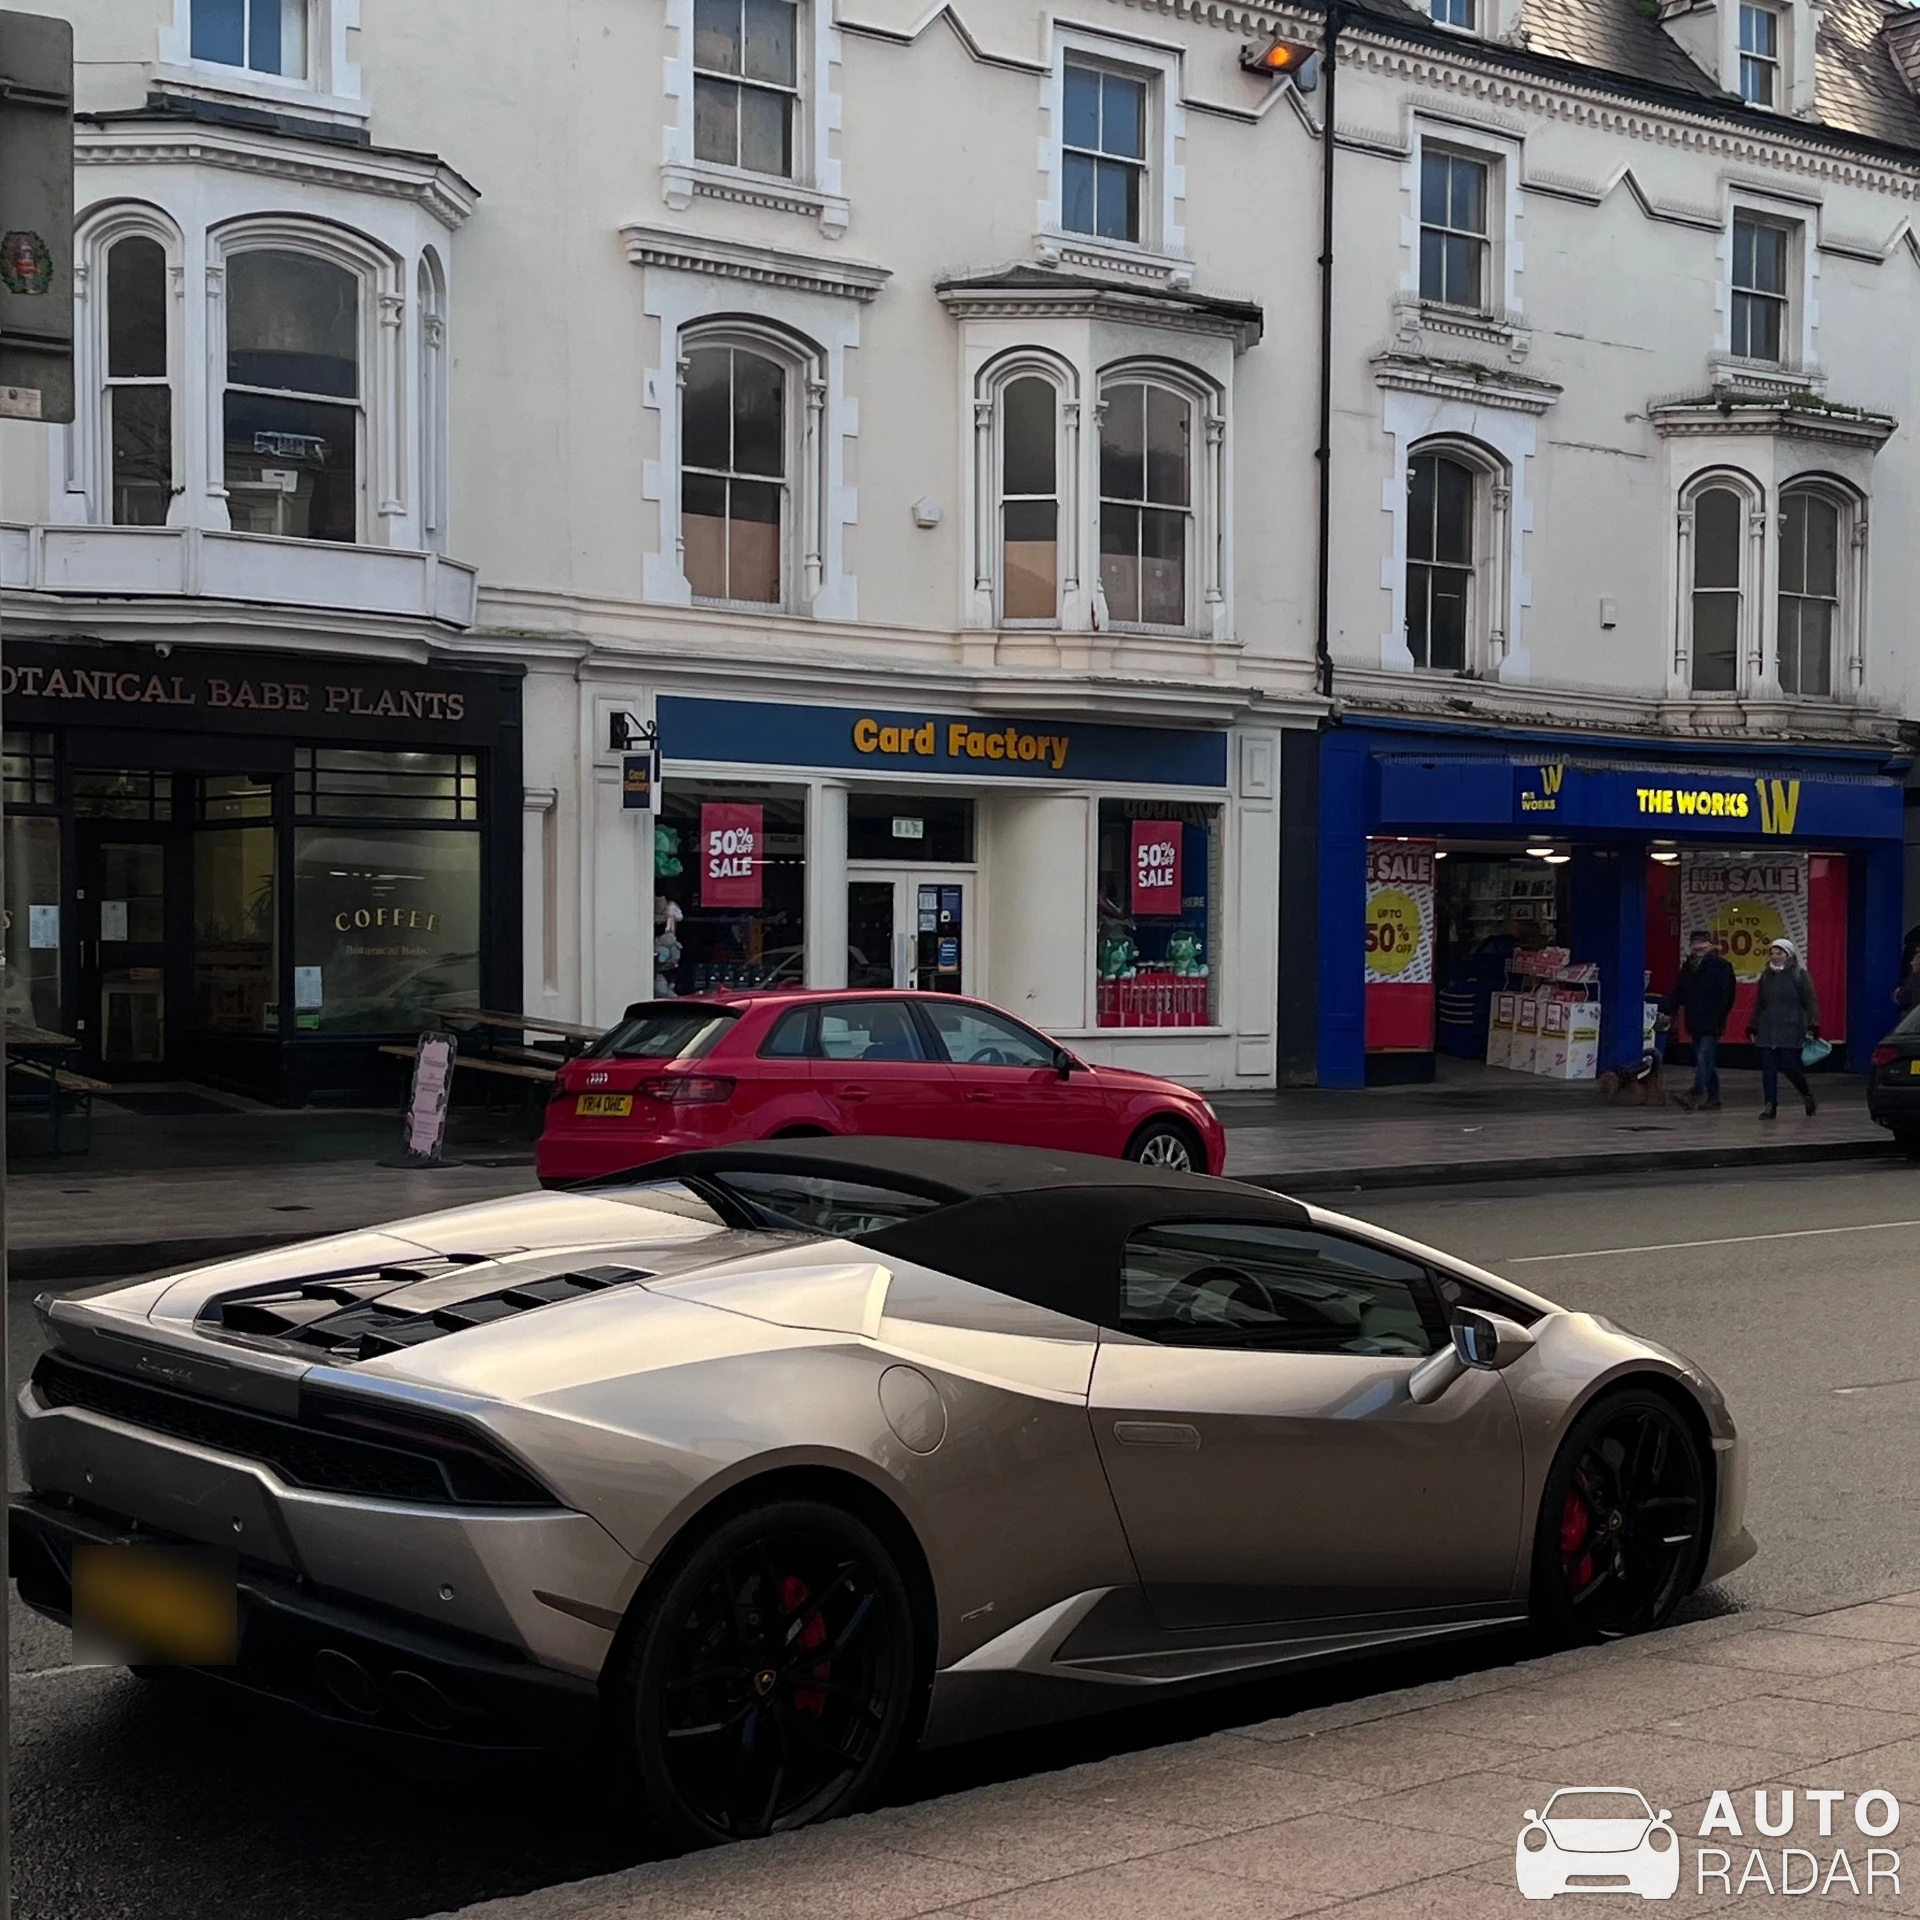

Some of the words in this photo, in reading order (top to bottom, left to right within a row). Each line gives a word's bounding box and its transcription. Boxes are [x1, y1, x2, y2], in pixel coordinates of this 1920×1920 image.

[207, 679, 309, 711] BABE
[325, 685, 465, 720] PLANTS
[854, 718, 934, 755] Card
[949, 723, 1069, 769] Factory
[1521, 799, 1556, 811] WORKS
[1636, 788, 1673, 813] THE
[1676, 790, 1749, 818] WORKS
[708, 827, 753, 856] 50%
[708, 856, 752, 878] SALE
[1138, 868, 1174, 888] SALE
[1377, 854, 1430, 881] SALE
[1691, 868, 1723, 880] BEST
[1691, 880, 1724, 891] EVER
[1728, 867, 1797, 892] SALE
[335, 907, 441, 934] COFFEE
[1377, 909, 1390, 919] UP
[1390, 909, 1402, 919] TO
[1745, 916, 1760, 926] TO
